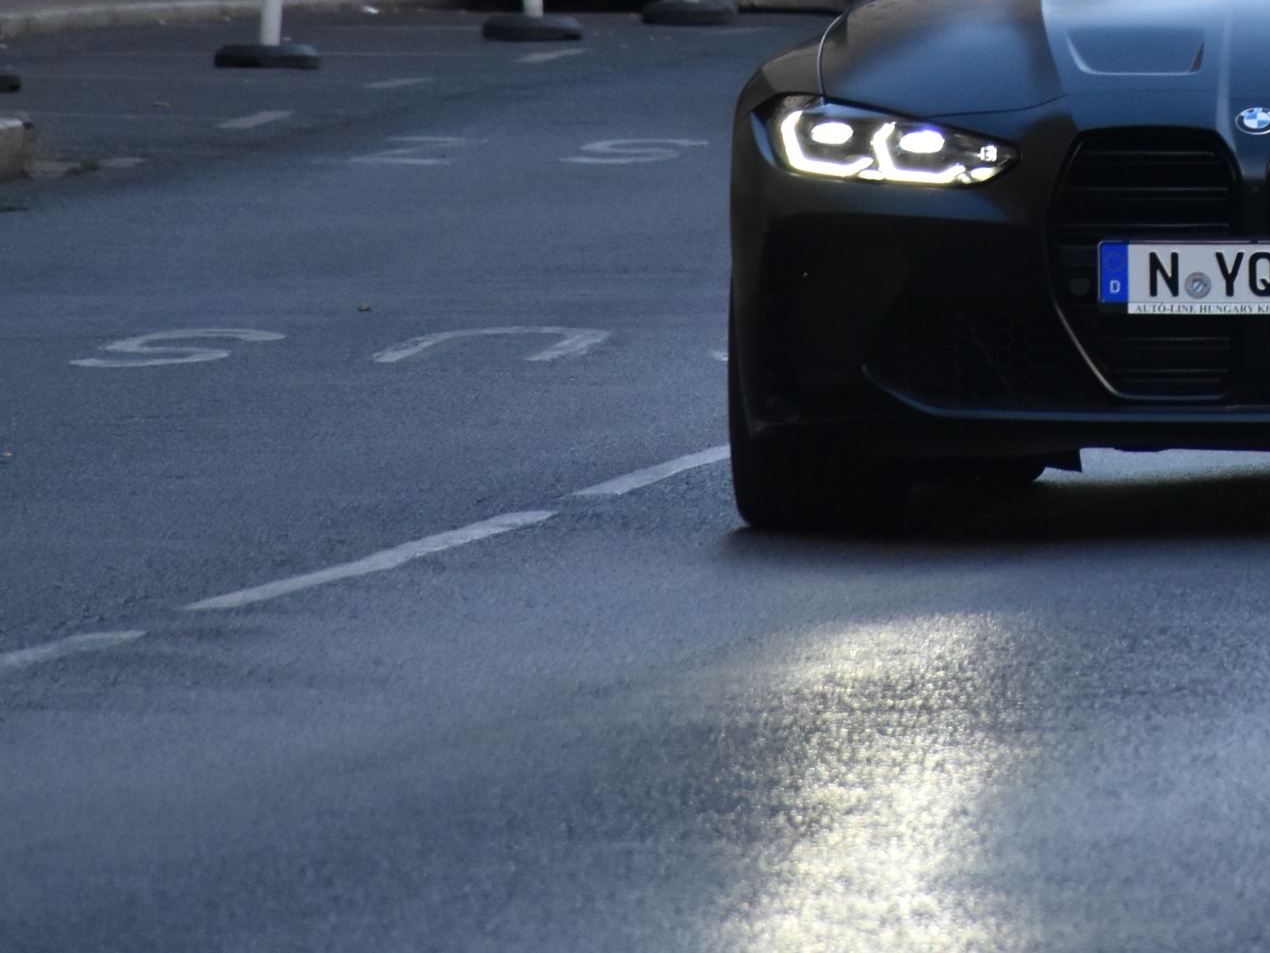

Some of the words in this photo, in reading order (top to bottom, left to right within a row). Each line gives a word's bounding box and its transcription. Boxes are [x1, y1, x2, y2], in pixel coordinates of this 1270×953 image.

[1149, 251, 1179, 297] N
[1109, 280, 1120, 293] D
[1200, 304, 1254, 313] HUNGARY
